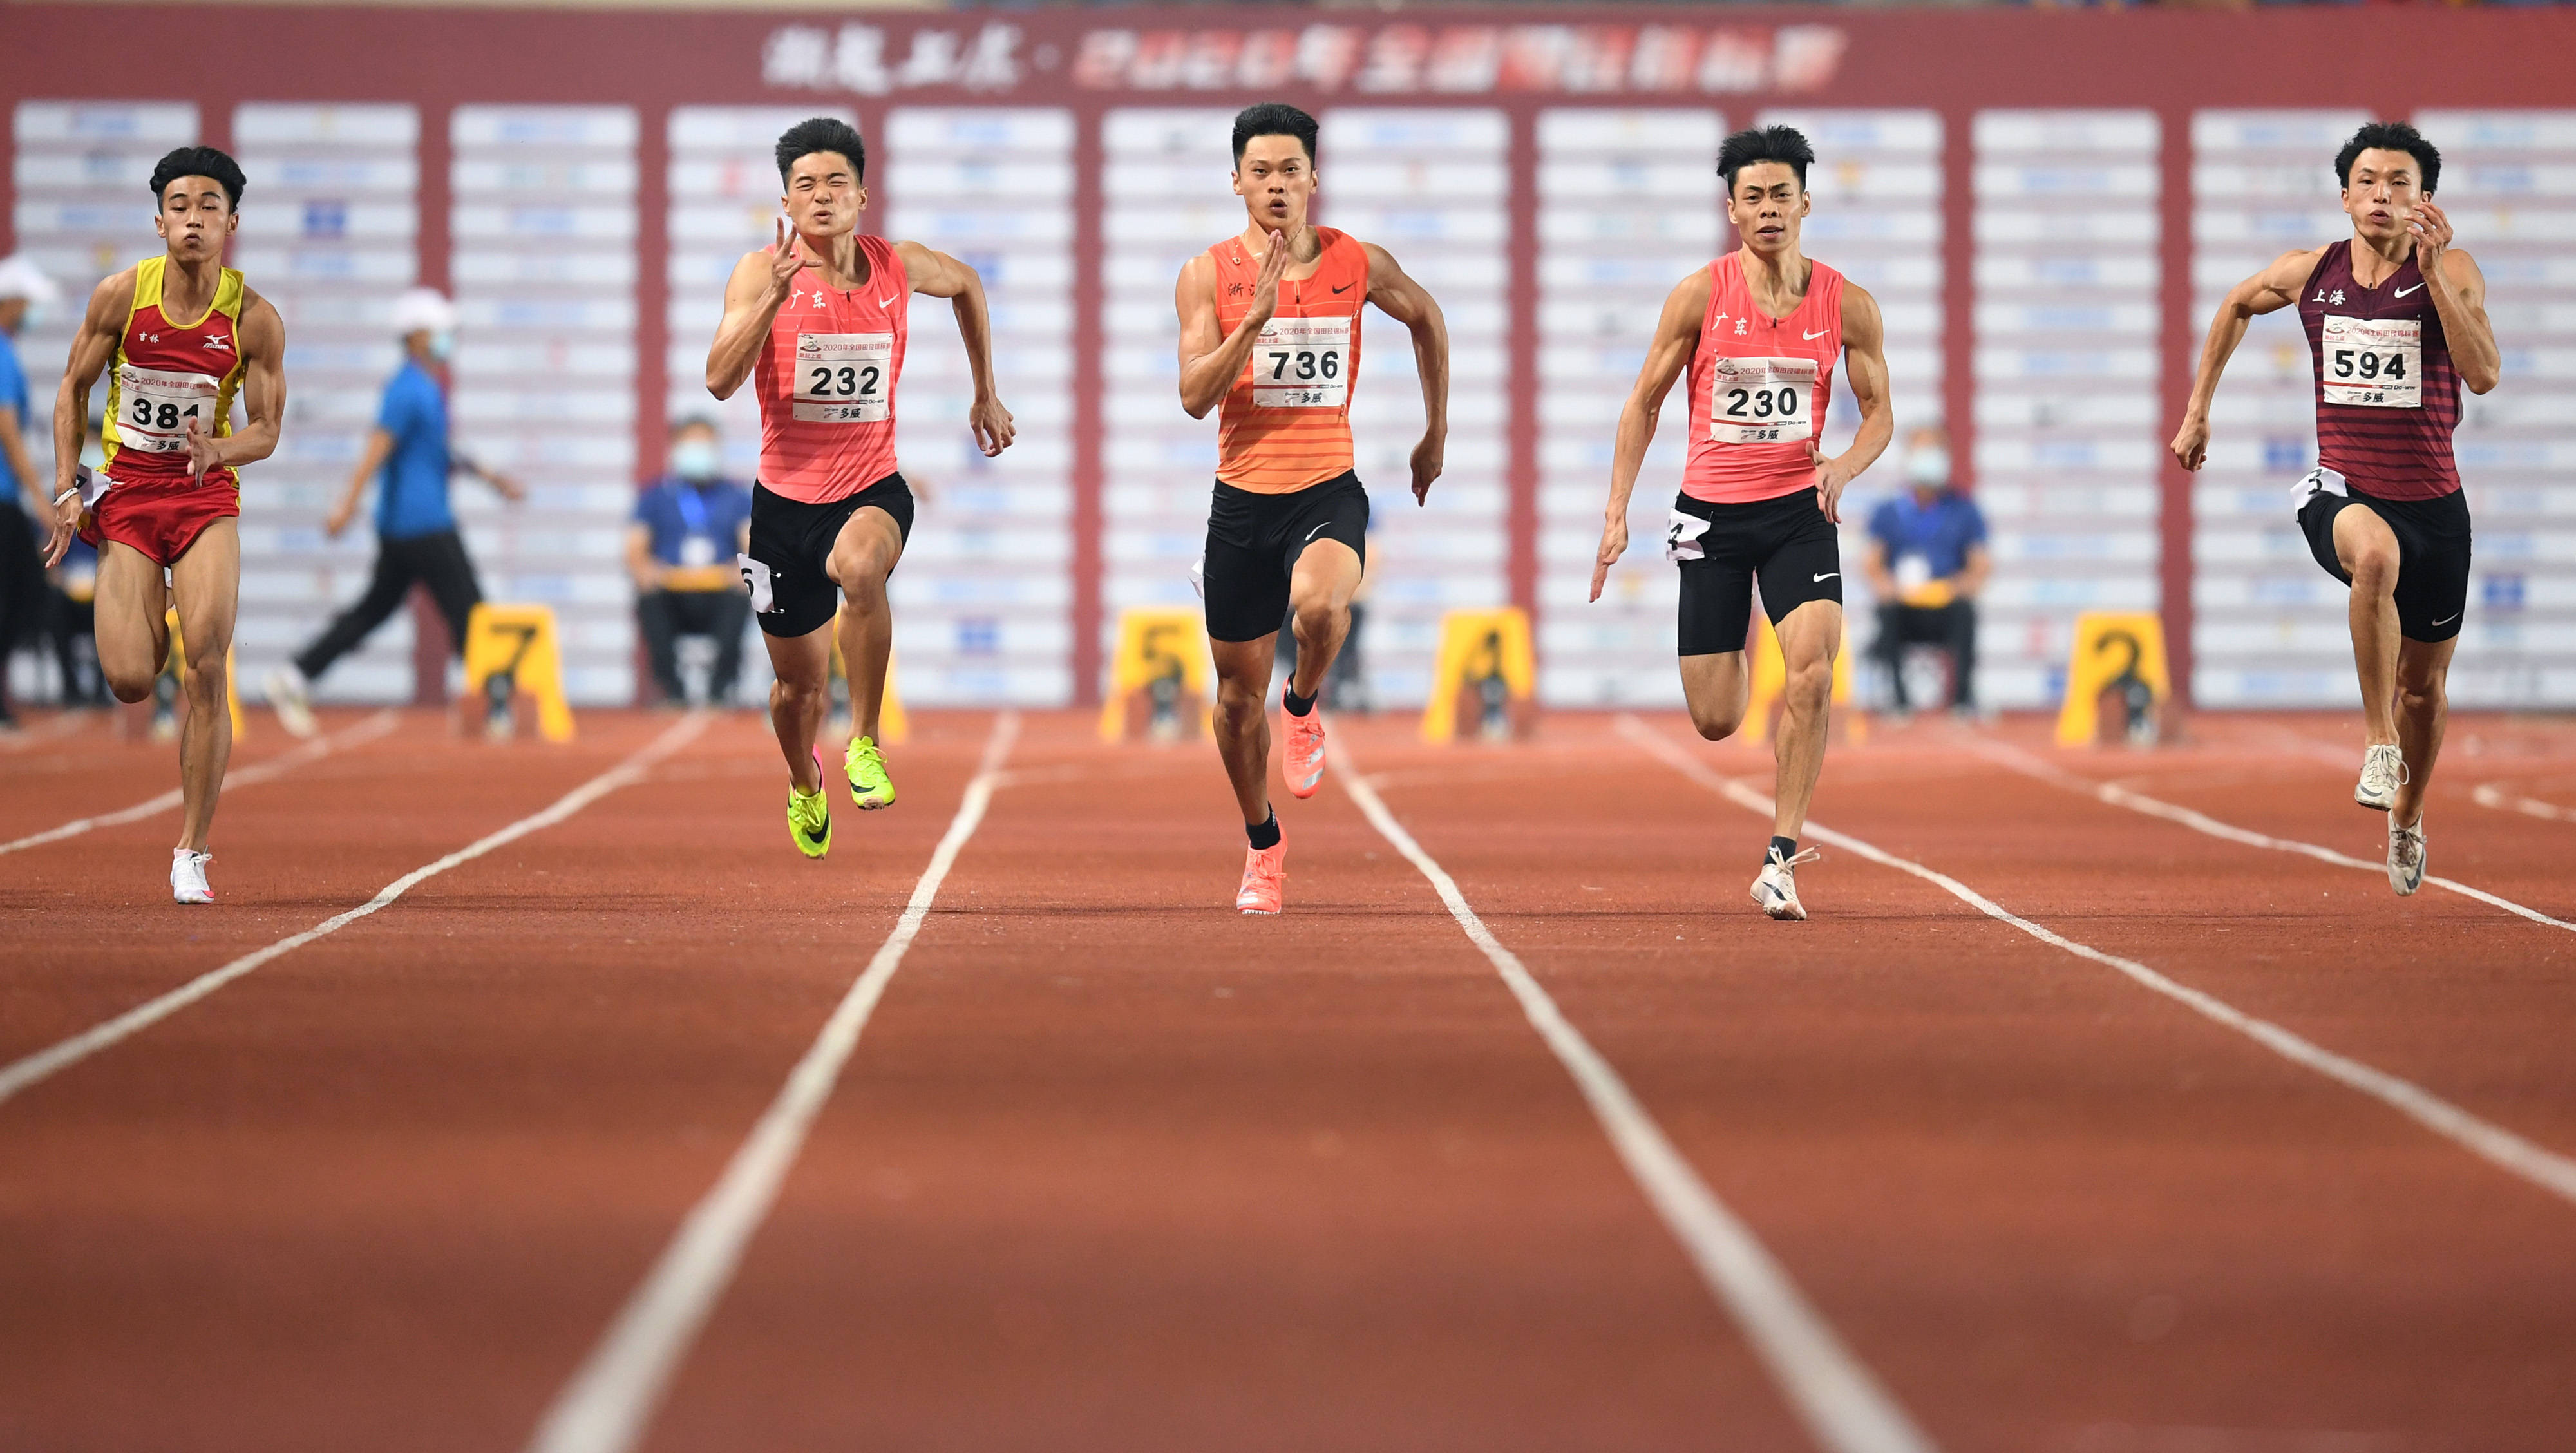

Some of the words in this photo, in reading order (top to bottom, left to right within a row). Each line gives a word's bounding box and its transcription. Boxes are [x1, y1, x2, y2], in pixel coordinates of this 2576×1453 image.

[789, 289, 826, 309] 广东
[2312, 288, 2346, 307] 上海
[138, 330, 160, 343] 吉林
[1712, 311, 1748, 336] 广东
[1269, 350, 1339, 380] 736
[2334, 350, 2406, 380] 594
[810, 366, 879, 395] 232
[1301, 392, 1323, 403] 多威
[1727, 387, 1797, 417] 230
[2363, 392, 2385, 403] 多威
[133, 398, 198, 429] 381
[840, 408, 861, 419] 多威
[156, 440, 180, 450] 多威
[1757, 429, 1779, 440] 多威
[2307, 468, 2323, 495] 3
[1667, 522, 1684, 551] 4
[489, 622, 538, 675] 7
[1142, 624, 1184, 685] 5
[2095, 629, 2141, 687] 2
